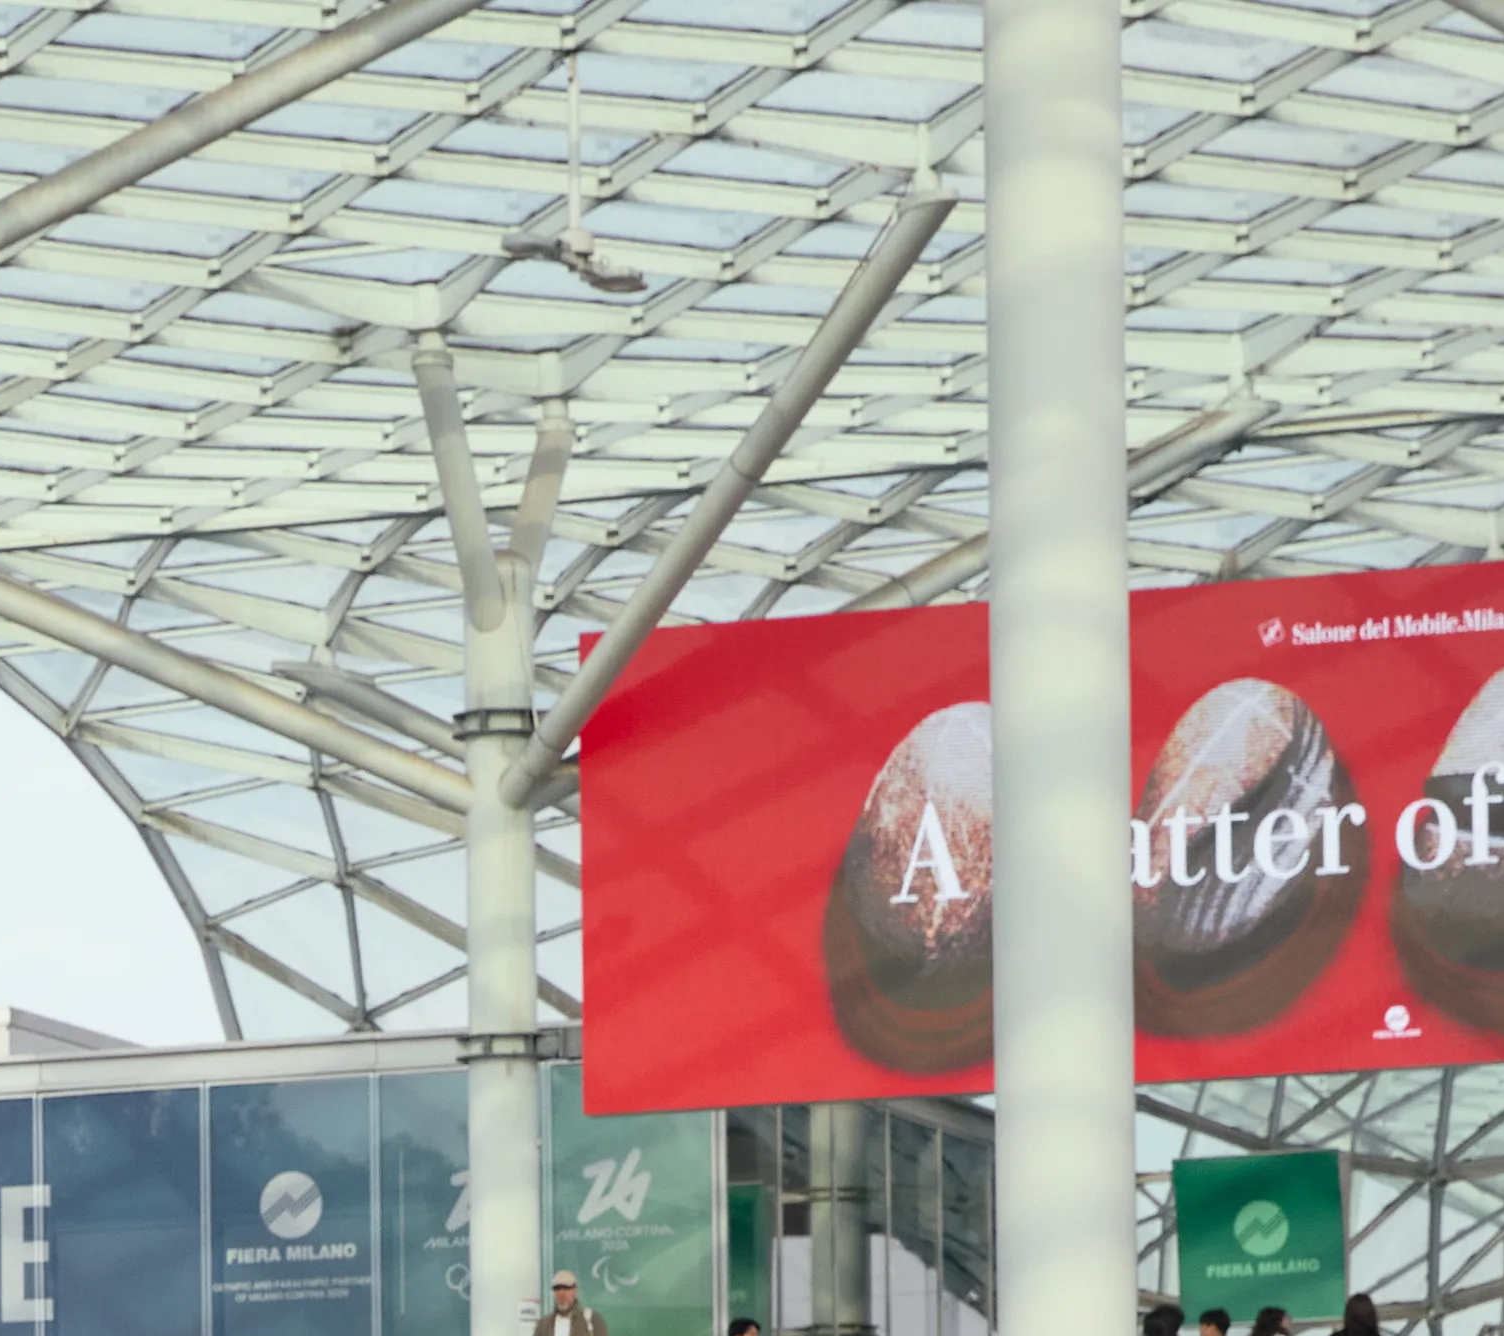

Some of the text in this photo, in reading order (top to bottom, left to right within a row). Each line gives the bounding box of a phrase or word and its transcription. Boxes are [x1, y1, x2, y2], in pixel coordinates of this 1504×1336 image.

[1292, 622, 1356, 645] Salone
[1360, 617, 1389, 641] del
[890, 799, 971, 904] A
[1130, 799, 1367, 889] atter
[226, 1243, 356, 1265] FIERA MILANO
[1206, 1258, 1320, 1279] FIERA MILANO
